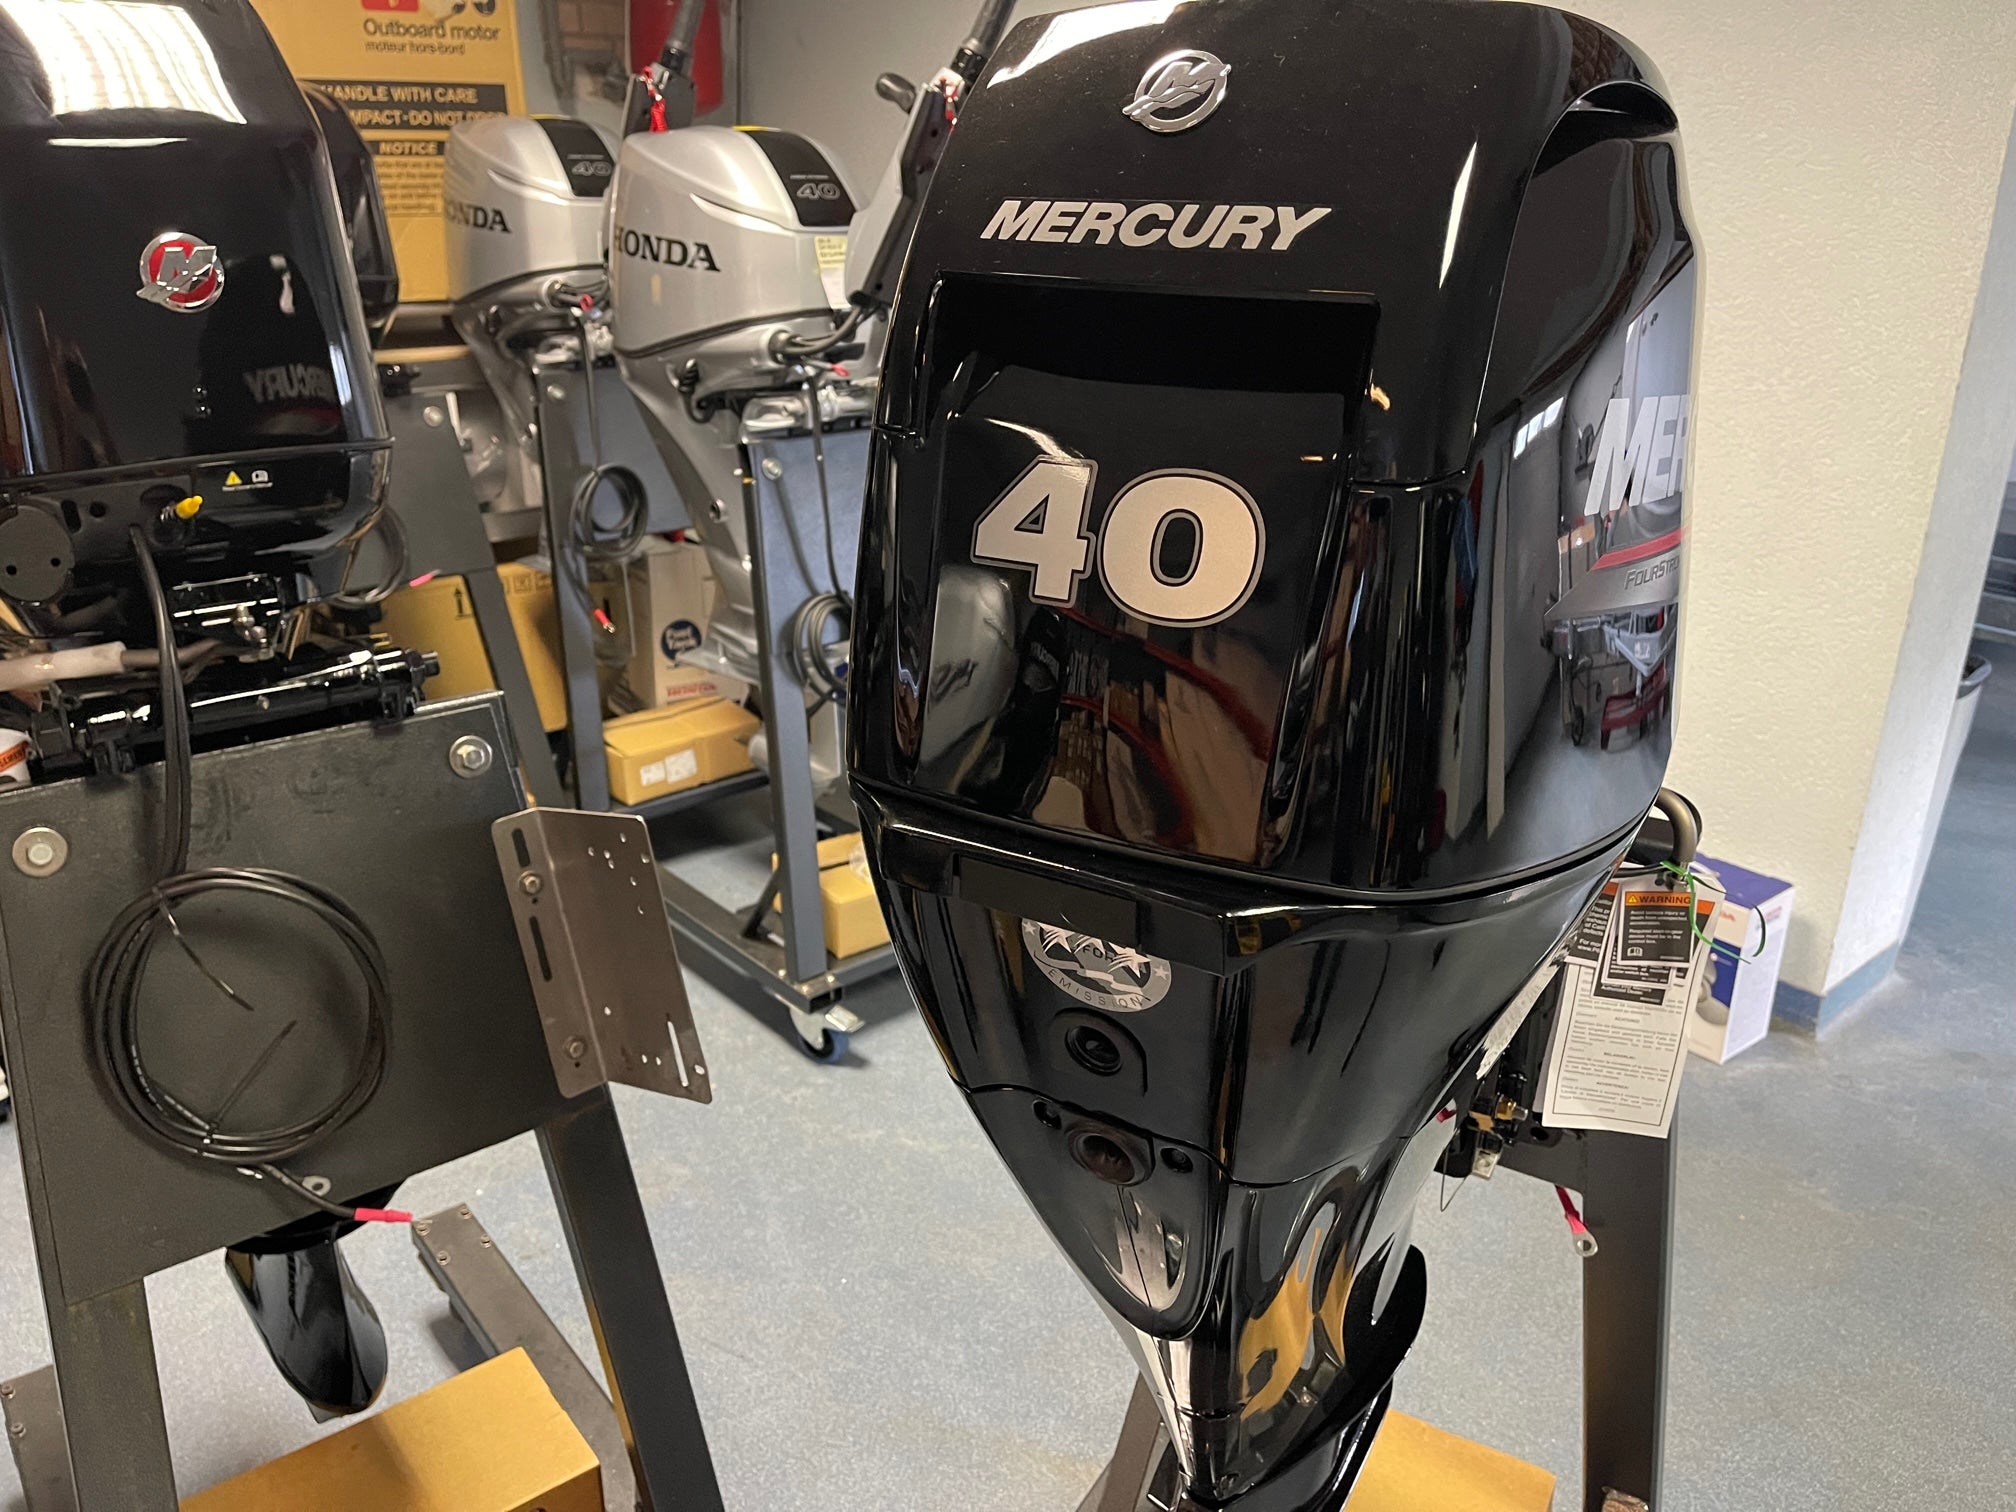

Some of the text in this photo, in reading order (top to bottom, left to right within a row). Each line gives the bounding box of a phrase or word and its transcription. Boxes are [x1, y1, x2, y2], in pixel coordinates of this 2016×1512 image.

[363, 18, 501, 41] Outboard motor
[390, 86, 433, 103] WITH
[434, 88, 478, 104] CARE
[349, 109, 402, 126] MPACT
[408, 110, 432, 126] DO
[379, 142, 438, 156] NOTICE
[571, 160, 613, 177] 40
[795, 182, 841, 200] 40
[980, 199, 1333, 251] MERCURY
[970, 454, 1266, 628] 40
[1639, 895, 1691, 905] WARNING
[1047, 968, 1143, 1008] EMISSION
